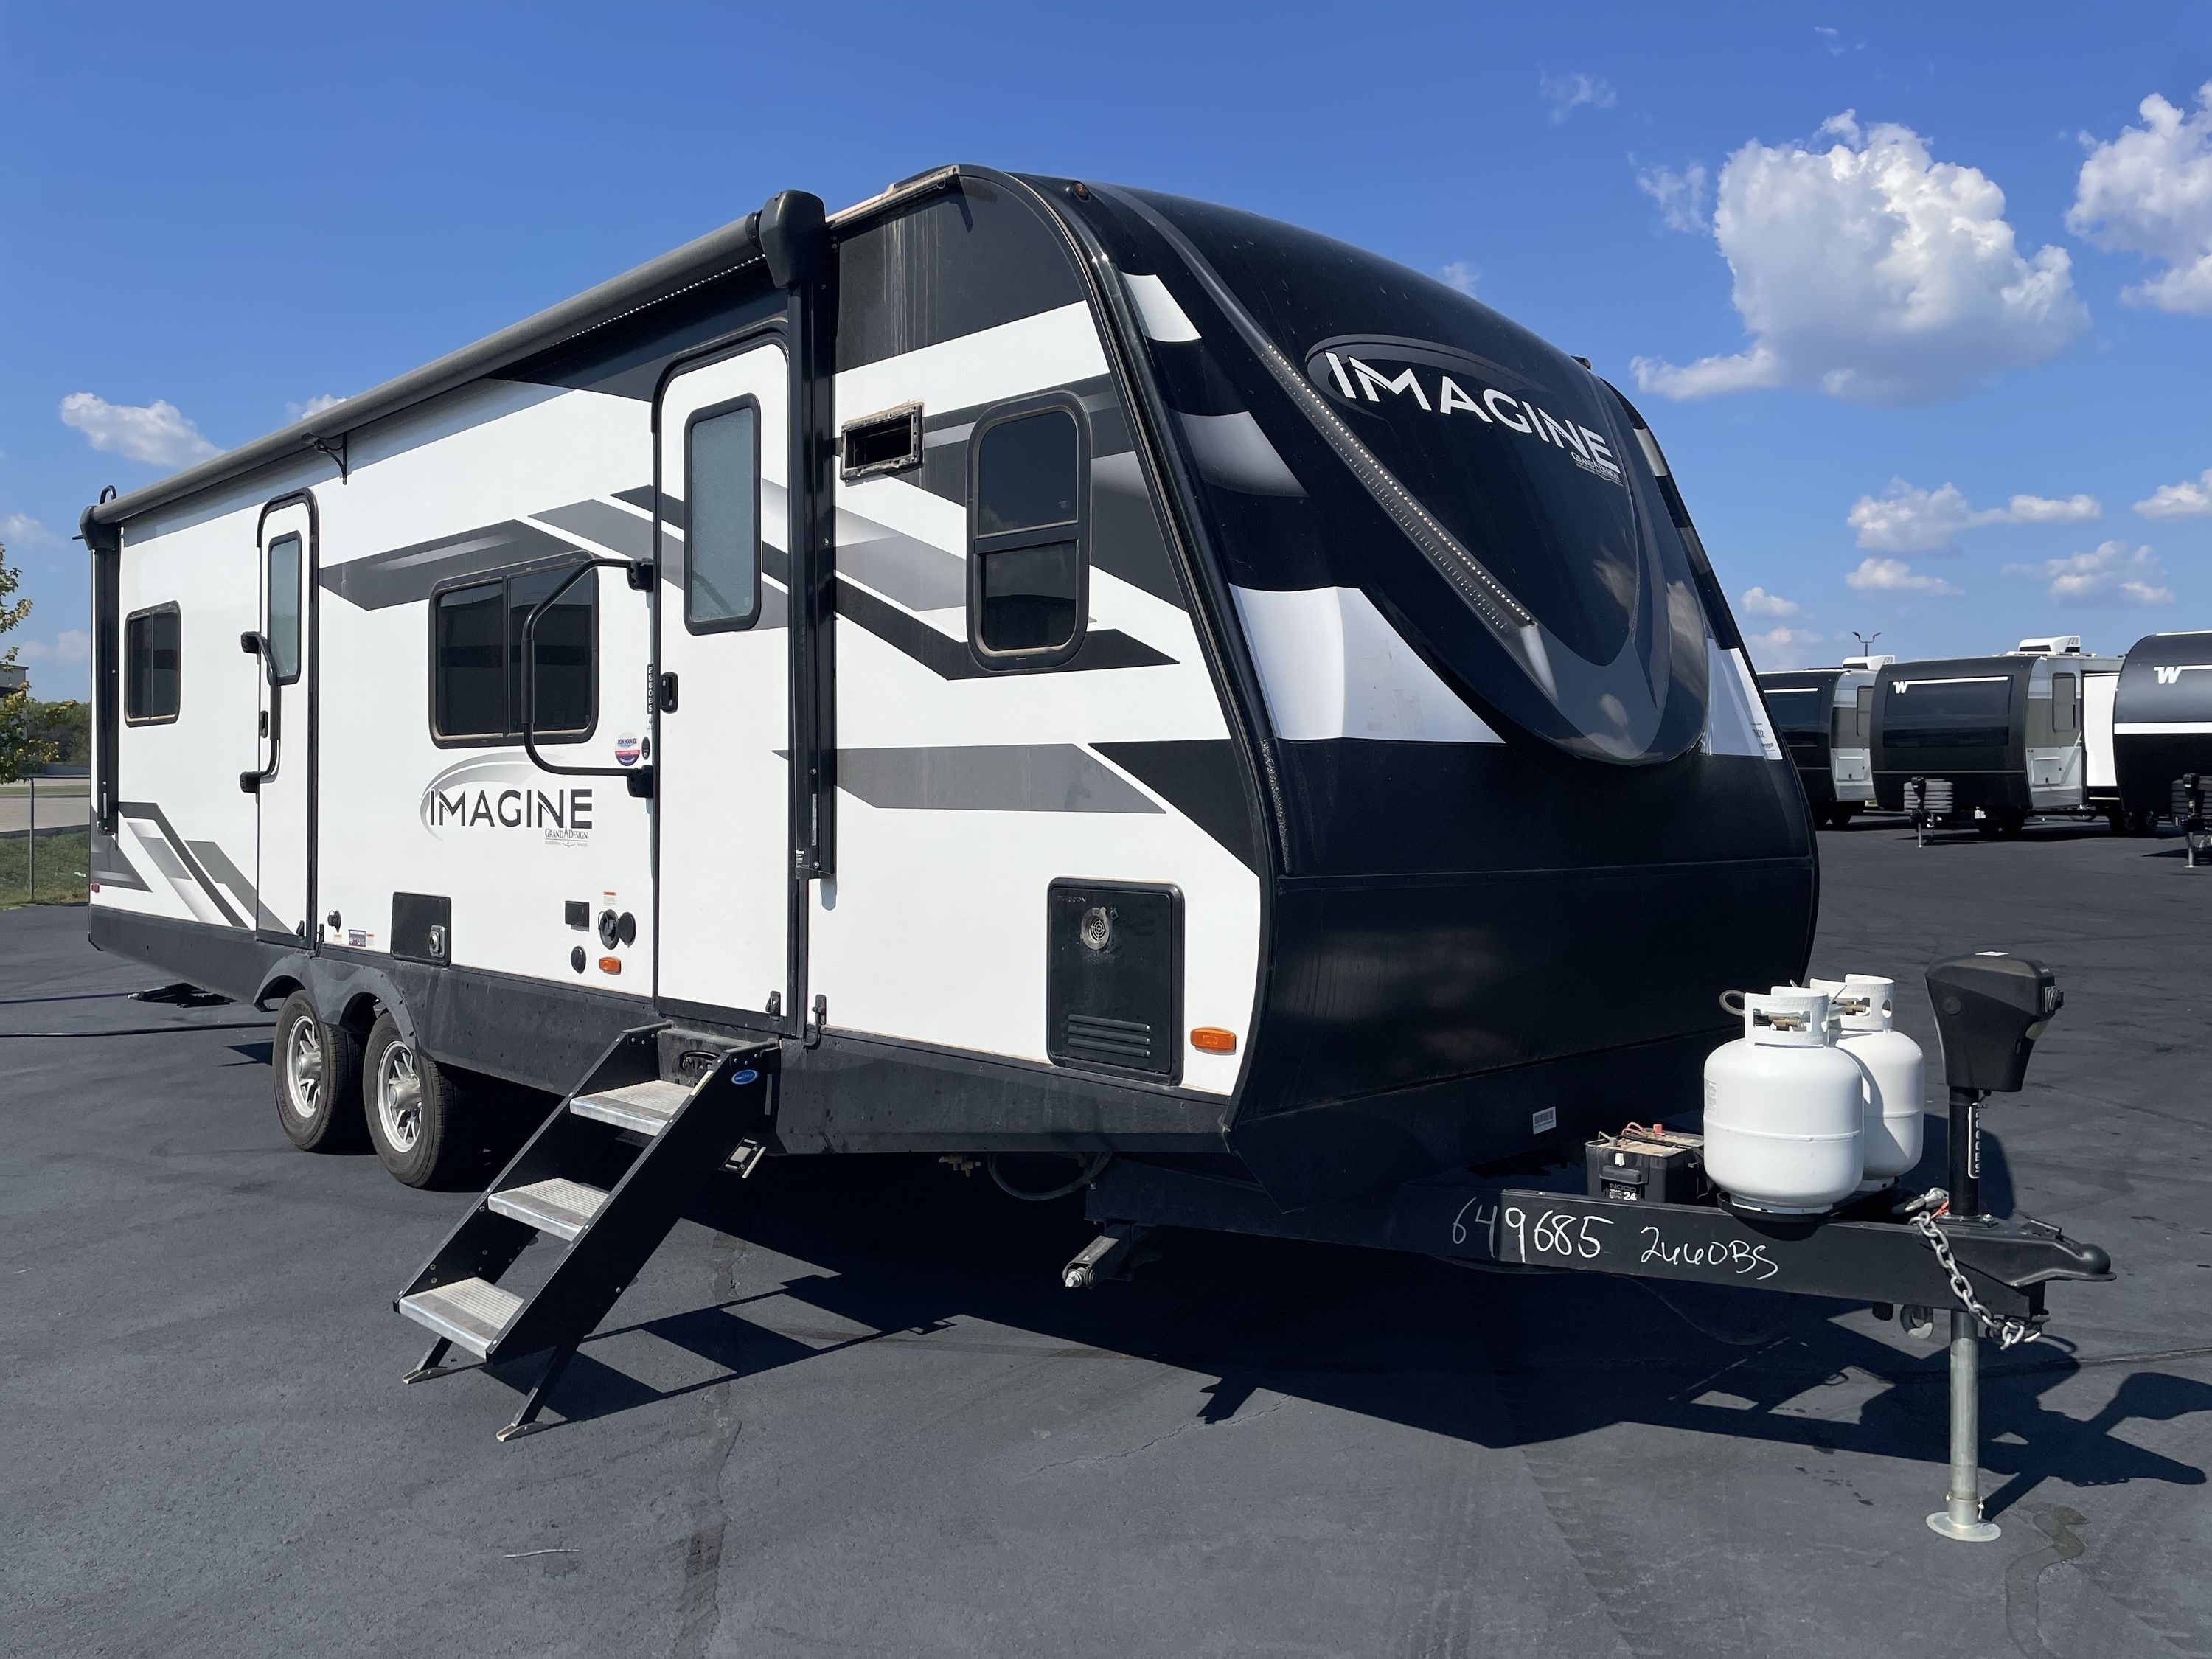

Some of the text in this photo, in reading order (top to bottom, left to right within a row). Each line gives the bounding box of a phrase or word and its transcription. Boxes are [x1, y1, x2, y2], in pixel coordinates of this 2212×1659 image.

[1325, 352, 1621, 474] IMAGINE
[430, 789, 593, 830] IMAGINE
[545, 828, 588, 840] GRAND DESIGN
[1610, 1183, 1637, 1193] NOCO
[1623, 1191, 1637, 1201] 24
[1452, 1197, 1614, 1263] 649685
